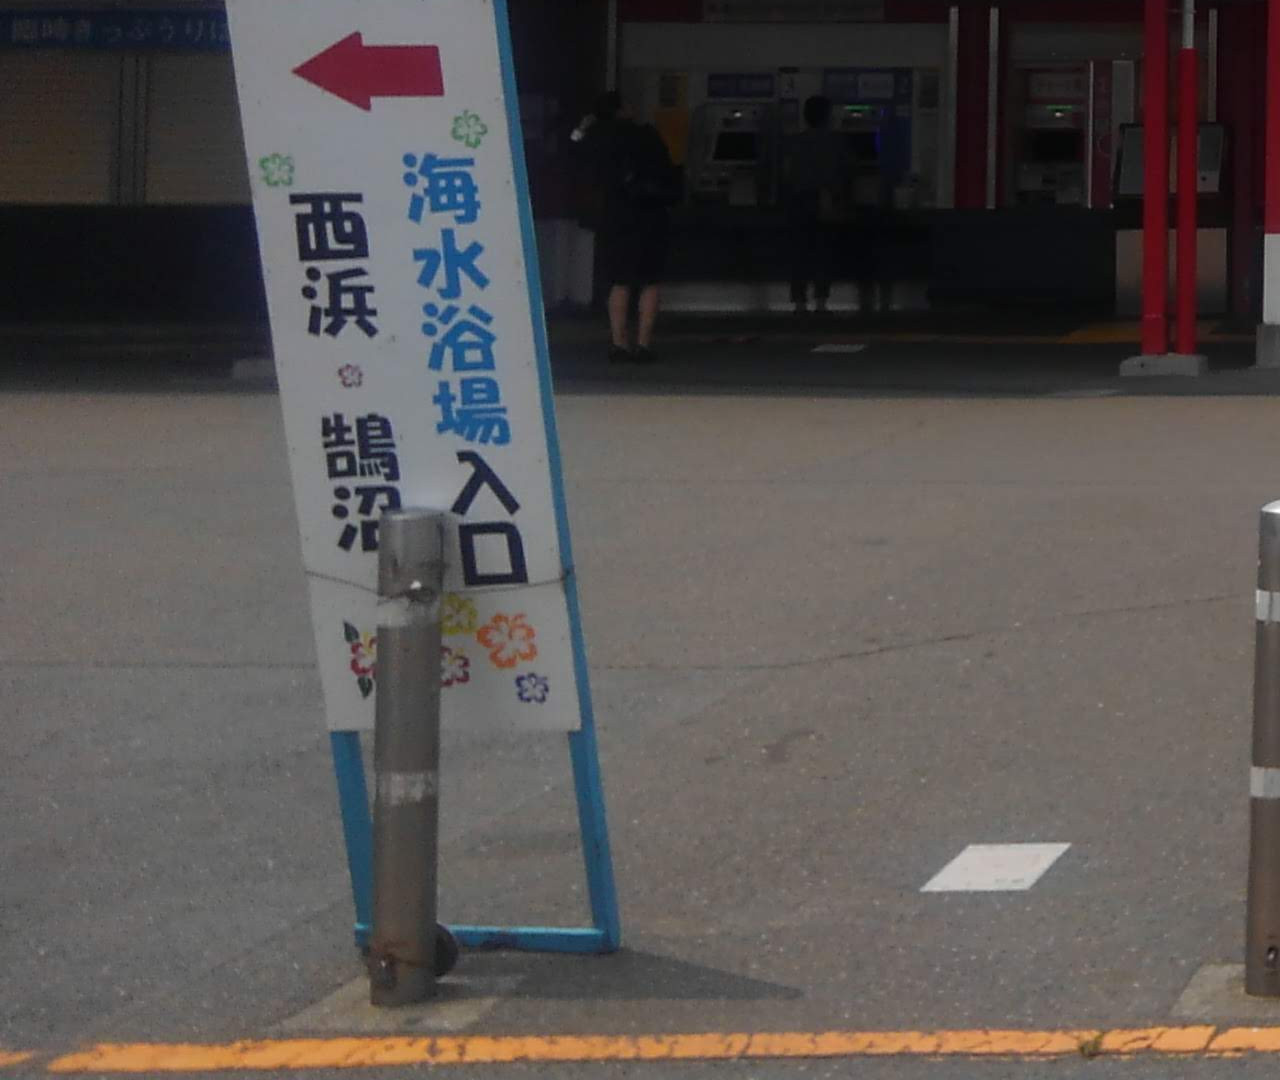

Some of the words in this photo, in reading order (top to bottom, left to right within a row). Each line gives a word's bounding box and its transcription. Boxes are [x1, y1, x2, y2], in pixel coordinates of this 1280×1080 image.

[289, 193, 379, 338] 西浜
[402, 152, 528, 586] 海水浴場入口
